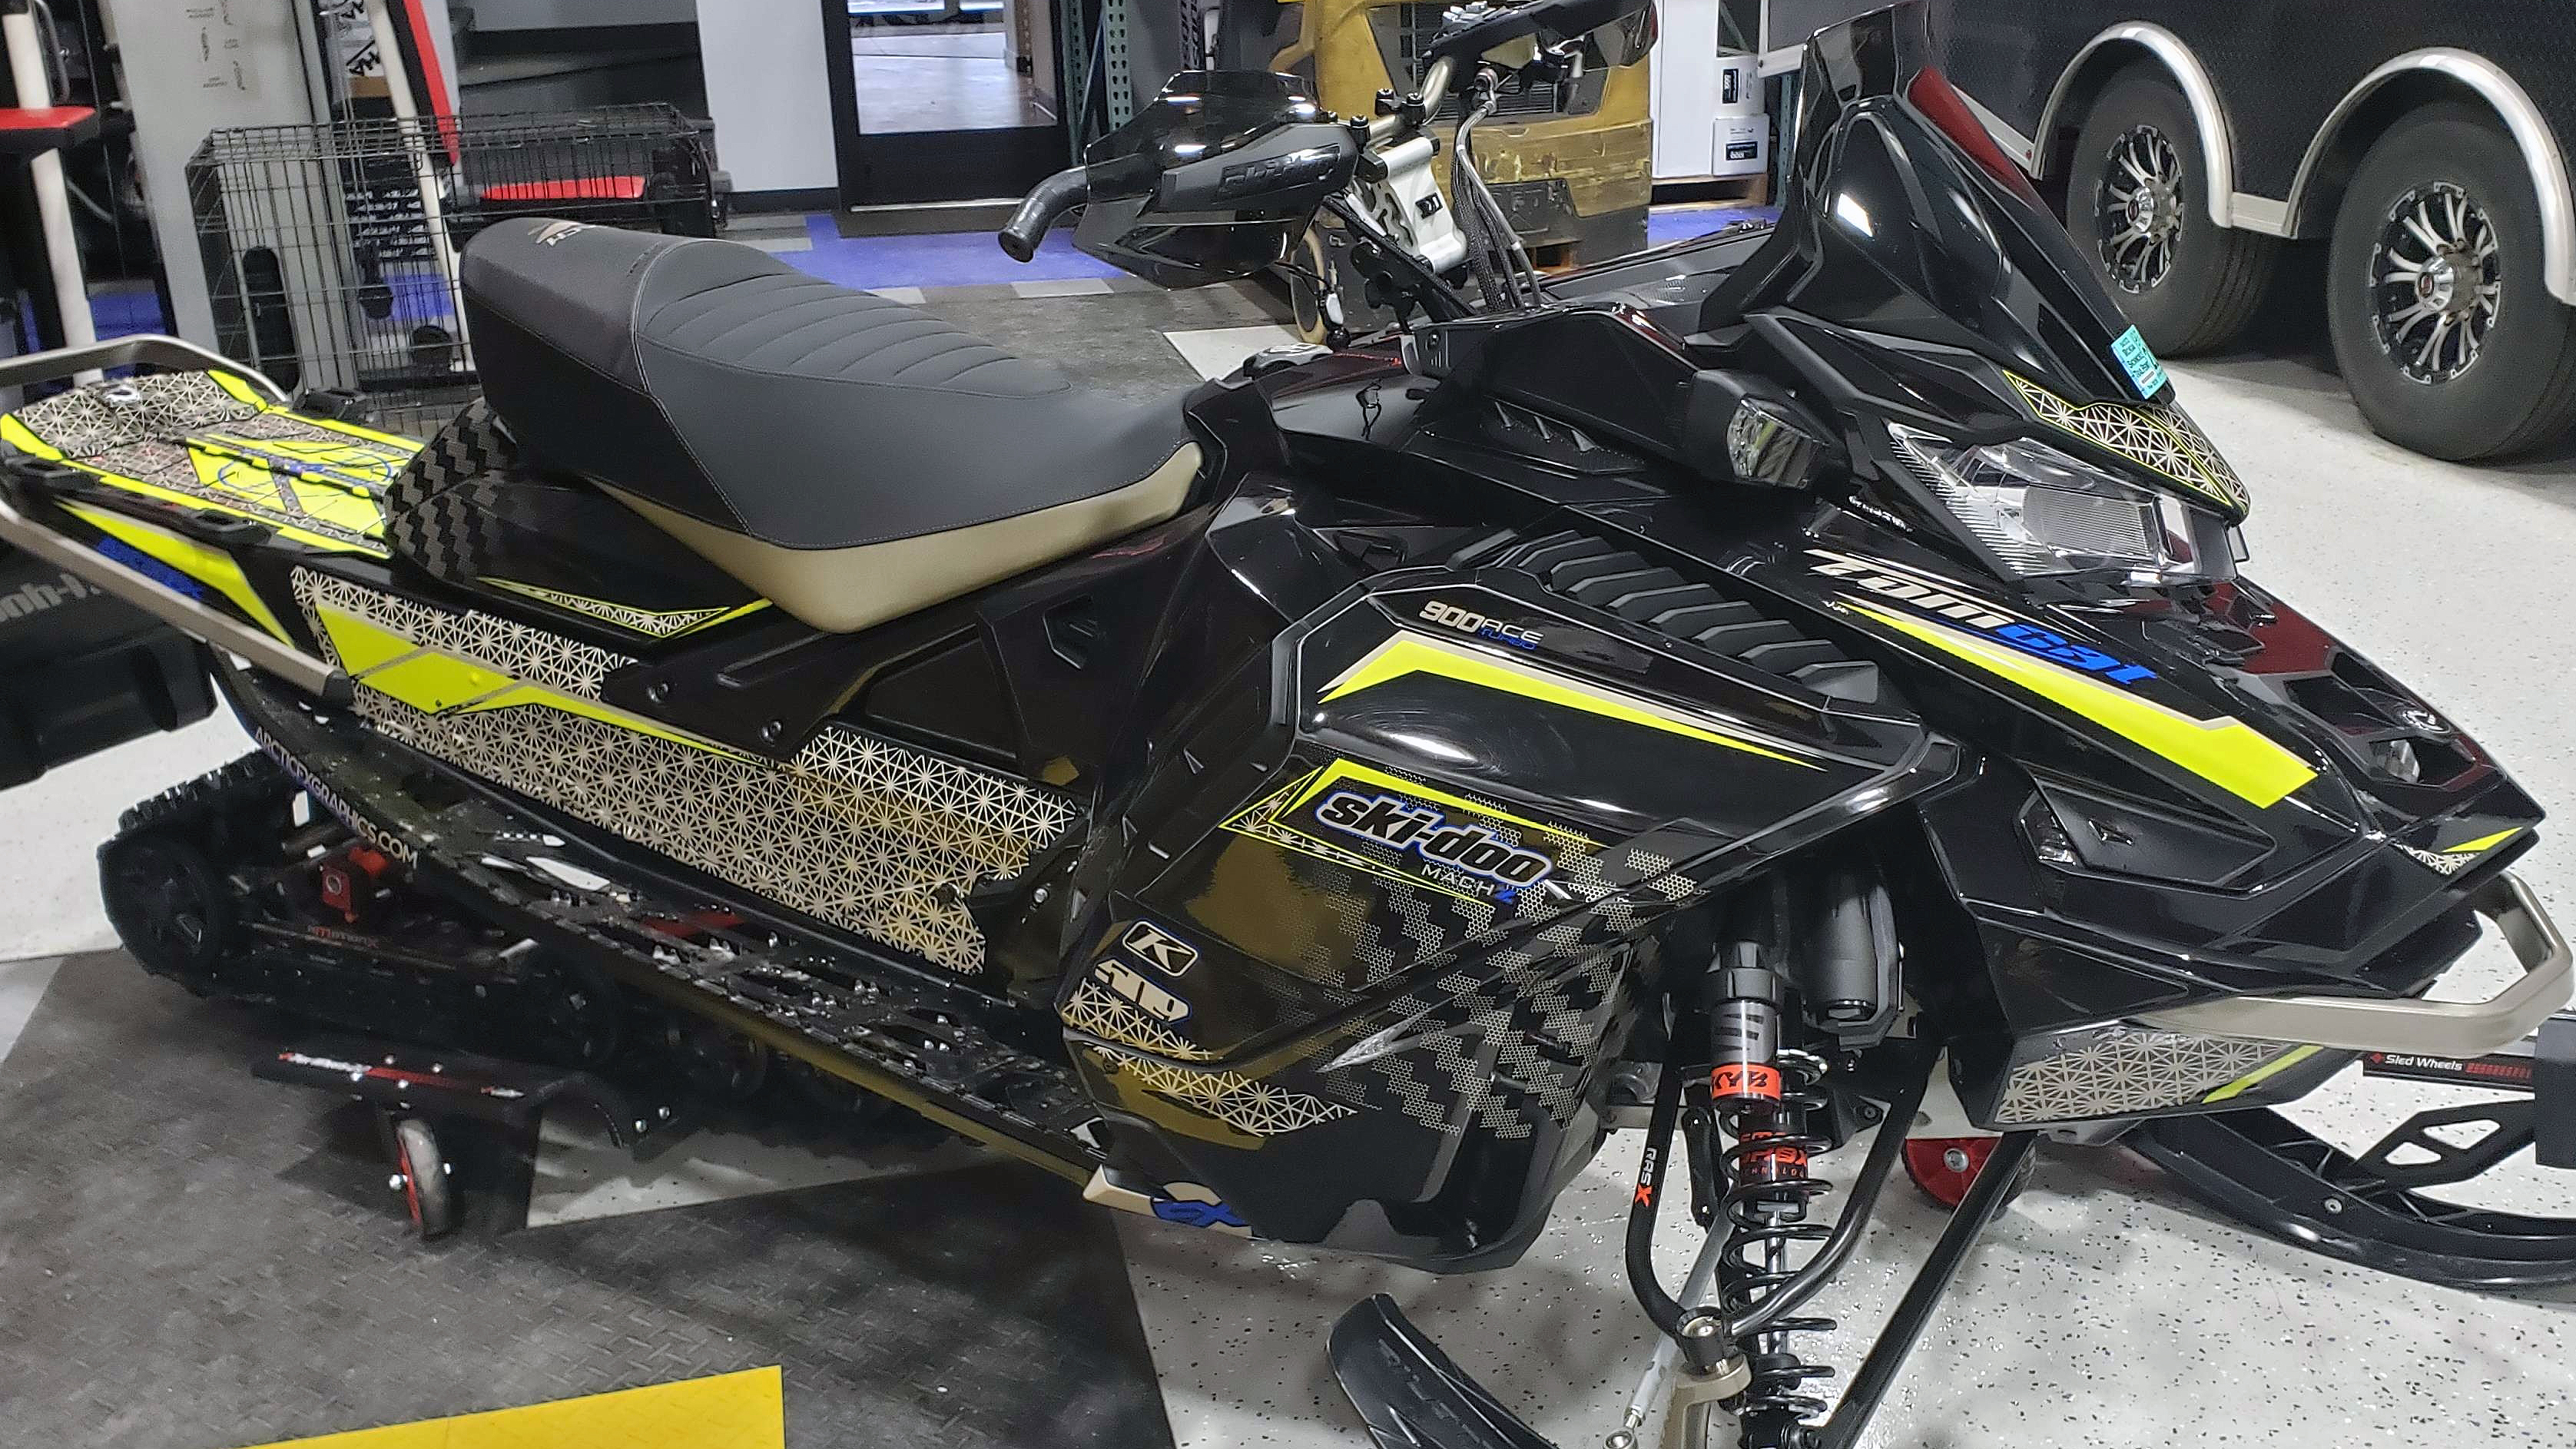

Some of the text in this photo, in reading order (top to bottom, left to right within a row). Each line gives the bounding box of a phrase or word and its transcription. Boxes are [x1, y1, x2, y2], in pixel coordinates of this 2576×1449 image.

[1419, 600, 1544, 645] 900 ACE
[1316, 792, 1553, 887] ski-doo
[1421, 863, 1496, 897] MACH
[2385, 1053, 2415, 1066] Sled
[2416, 1057, 2463, 1072] Wheels
